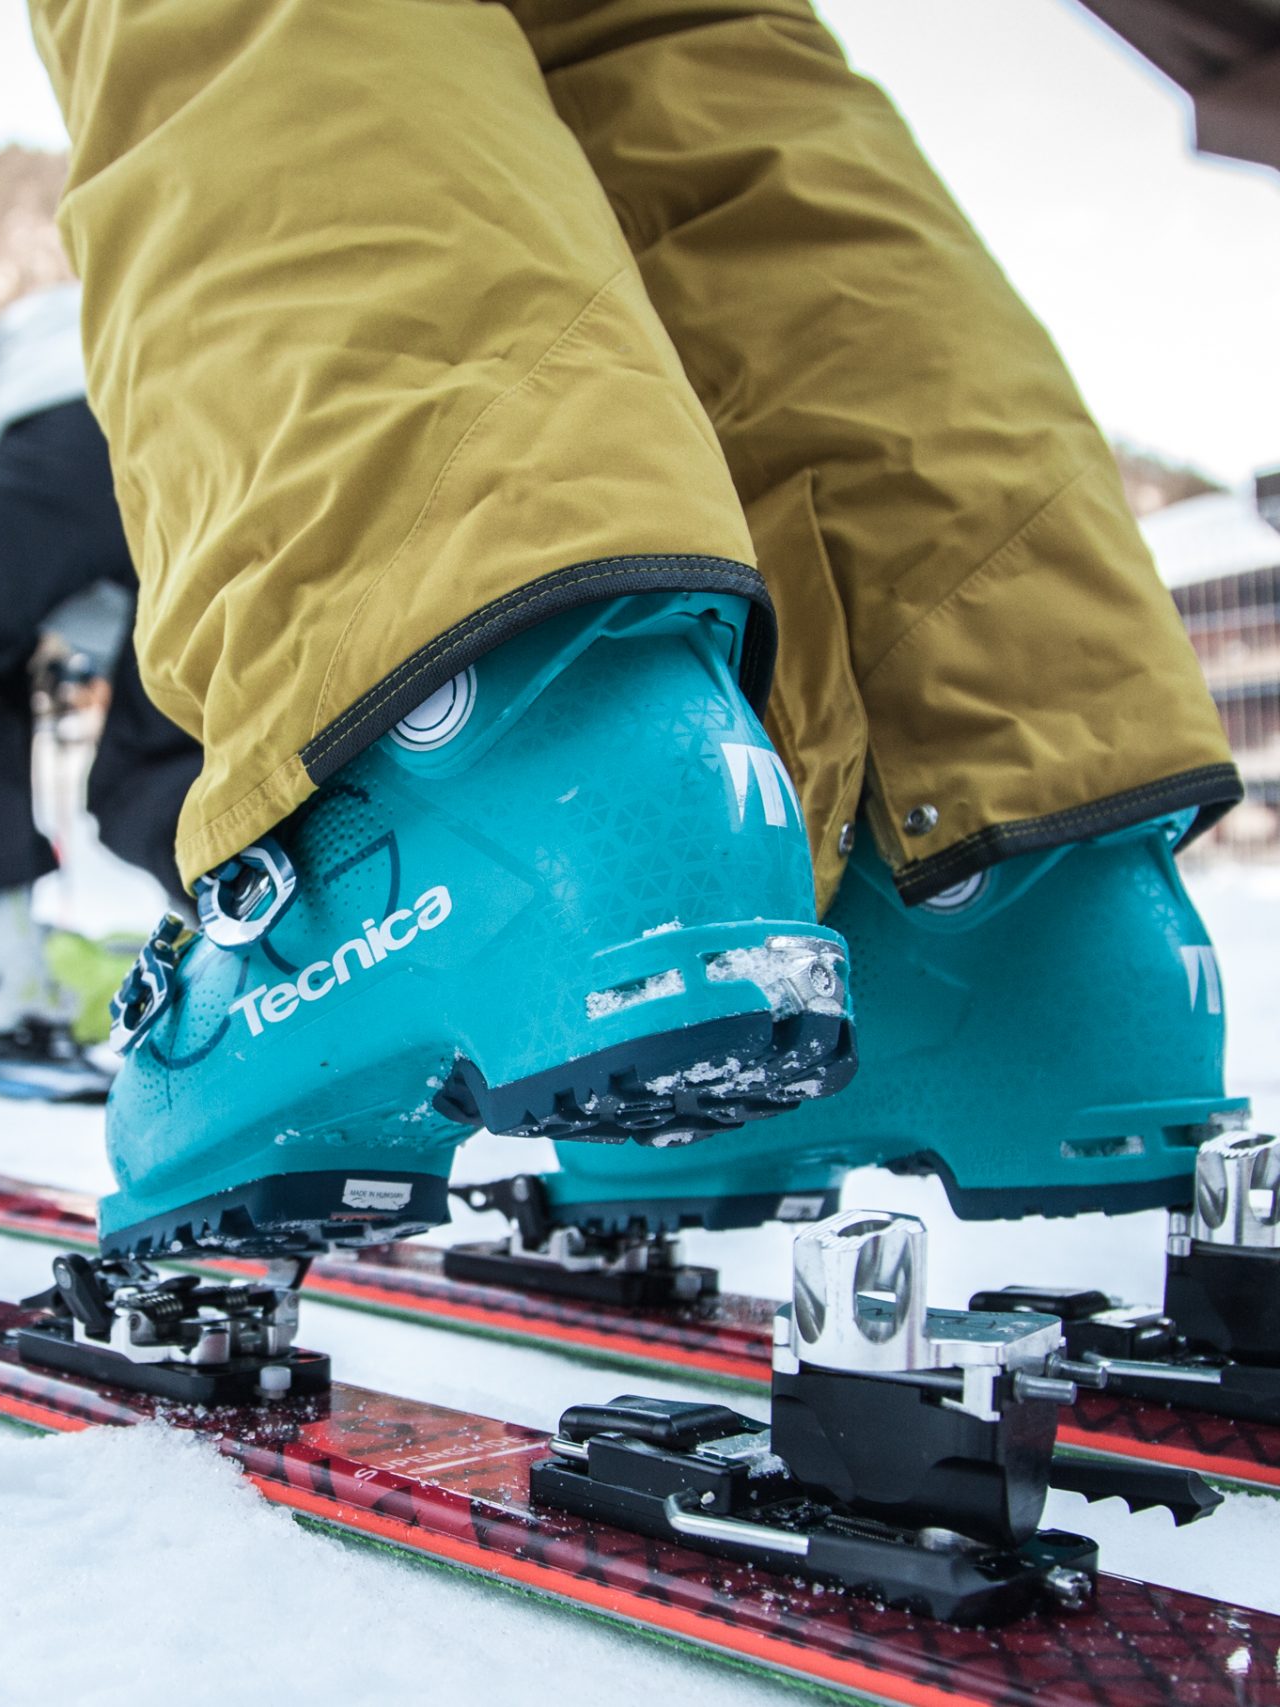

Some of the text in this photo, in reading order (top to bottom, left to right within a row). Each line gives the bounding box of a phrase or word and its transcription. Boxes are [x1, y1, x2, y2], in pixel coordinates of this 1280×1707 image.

[228, 885, 453, 1037] Tecnica
[350, 1190, 367, 1198] MADE
[376, 1191, 404, 1199] HUNGARY
[353, 1435, 527, 1481] SUPERGUIDE
